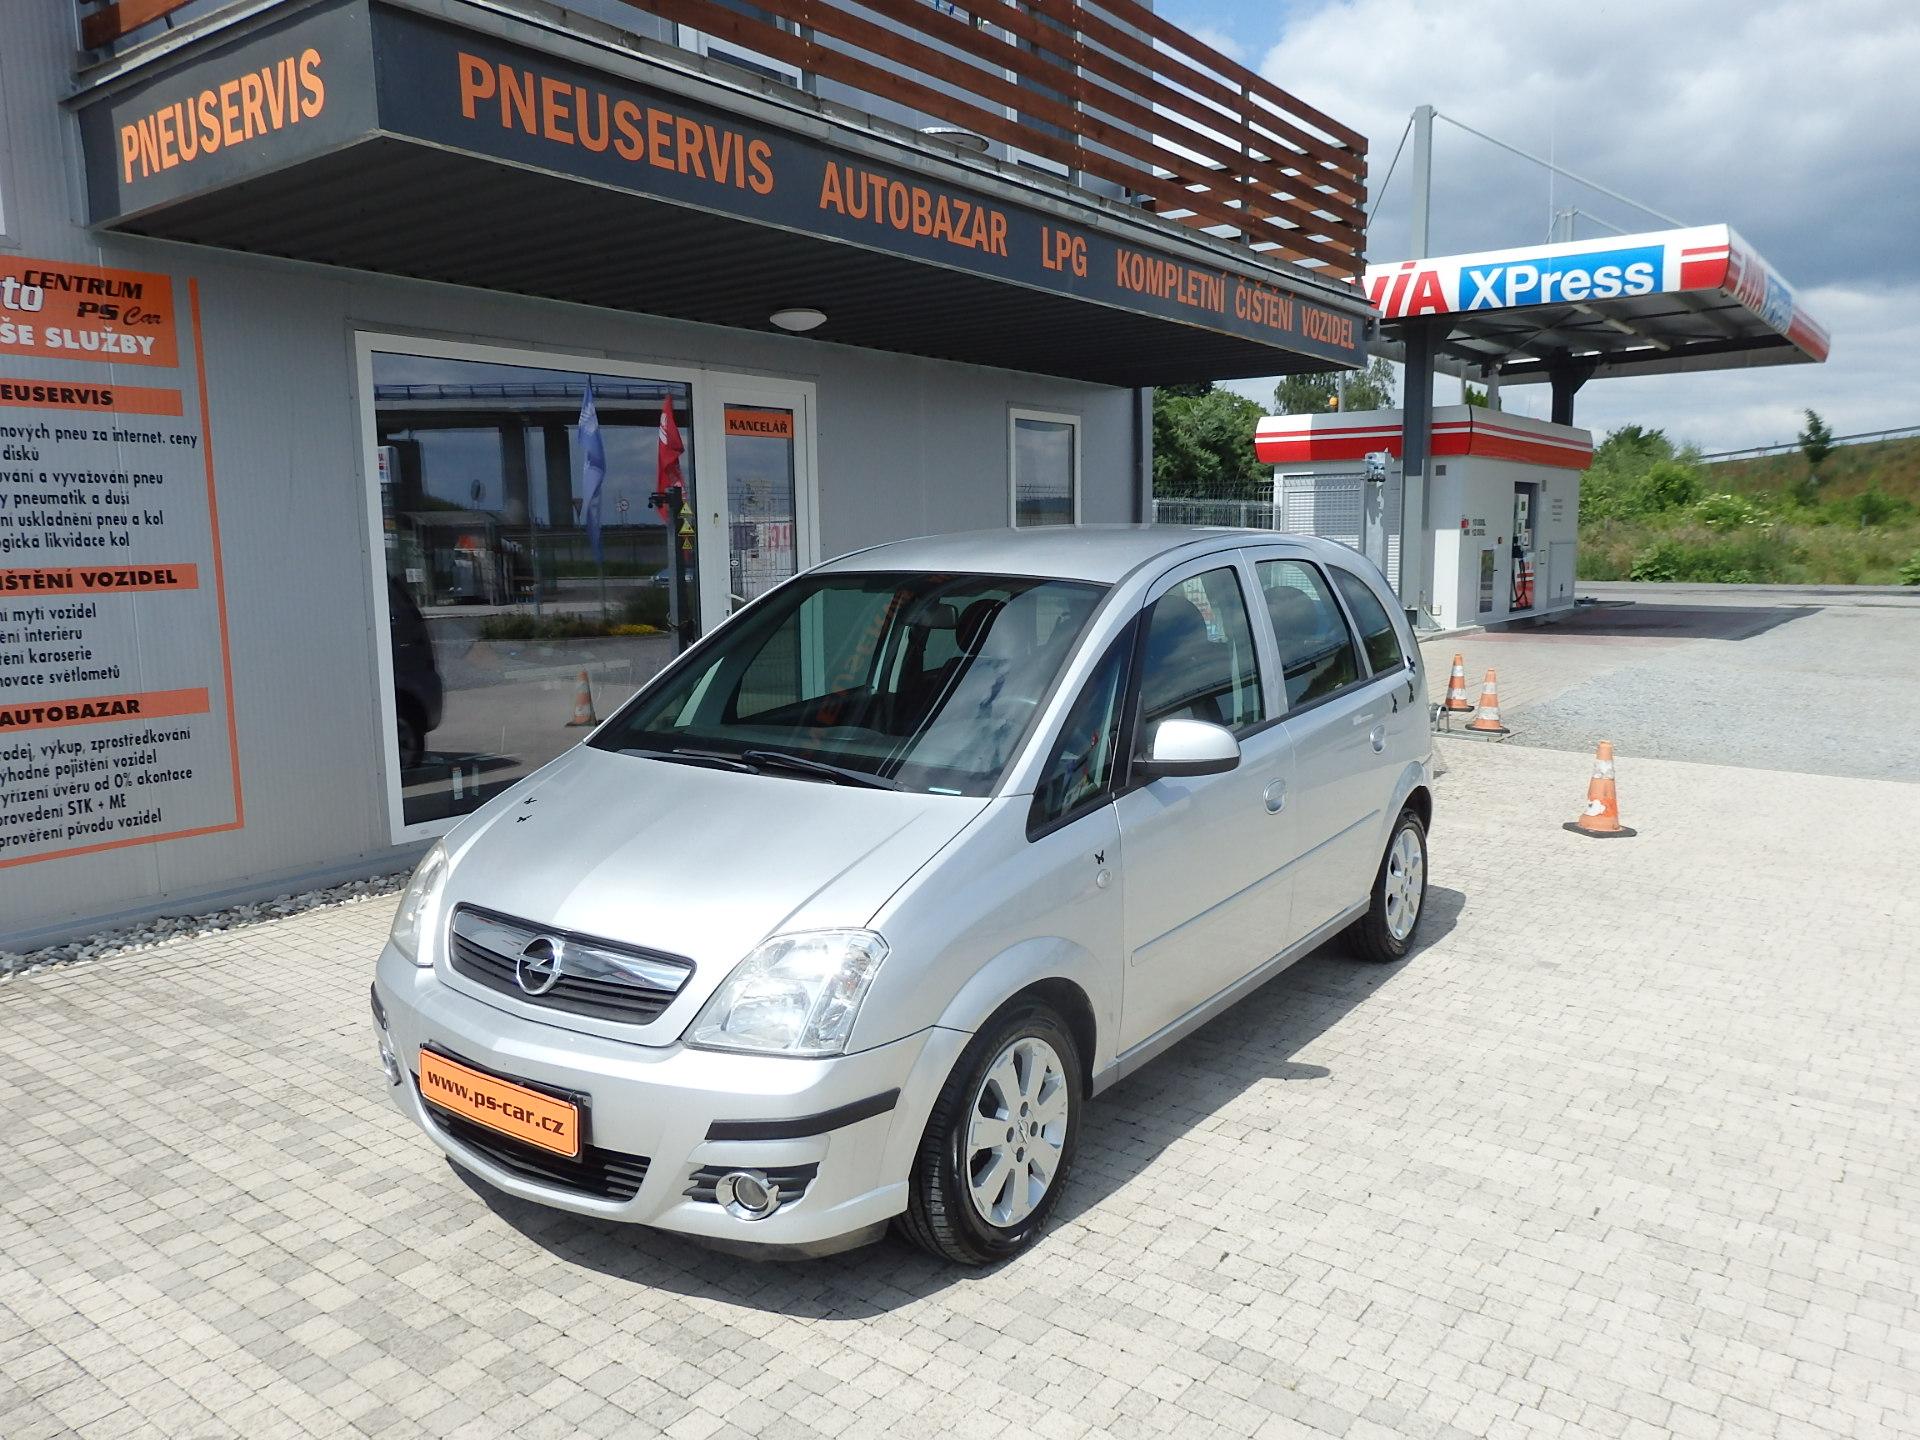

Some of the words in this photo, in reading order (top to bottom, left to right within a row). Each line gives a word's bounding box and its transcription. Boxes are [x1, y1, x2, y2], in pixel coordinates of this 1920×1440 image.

[121, 48, 325, 184] PNEUSERVIS
[457, 51, 774, 195] PNEUSERVIS
[819, 160, 1008, 257] AUTOBAZAR
[1042, 226, 1088, 277] LPG
[1116, 248, 1227, 314] KOMPLETNÍ
[1235, 274, 1296, 332] ČIŠTĚNÍ
[1301, 305, 1355, 349] VOZIDEL
[24, 269, 143, 300] CENTRUM
[1469, 262, 1655, 312] XPress
[76, 301, 119, 321] PS
[123, 306, 162, 326] Car
[0, 316, 34, 346] ŠE
[45, 326, 155, 356] SLUŽBY
[0, 383, 114, 406] EUSERVIS
[0, 423, 50, 442] nových
[55, 428, 88, 443] pneu
[92, 430, 108, 441] za
[112, 427, 166, 445] internet.
[169, 434, 198, 449] ceny
[729, 419, 788, 434] KANCELÁŘ
[3, 444, 39, 461] disků
[40, 472, 47, 483] a
[50, 469, 129, 487] vyvažování
[133, 473, 163, 488] pneu
[14, 490, 87, 509] pneumatik
[92, 494, 100, 505] a
[18, 510, 92, 527] uskladnění
[96, 514, 127, 529] pneu
[132, 516, 140, 525] a
[144, 510, 164, 525] kol
[0, 533, 40, 553] gická
[45, 532, 105, 549] likvidace
[110, 531, 130, 546] kol
[81, 570, 178, 587] VOZIDEL
[49, 602, 97, 619] vozidel
[25, 626, 83, 642] interiéru
[29, 646, 92, 663] karoserie
[49, 665, 120, 684] světlometů
[0, 700, 140, 727] AUTOBAZAR
[91, 726, 191, 753] zprostředkování
[55, 757, 109, 780] pojištění
[113, 749, 157, 768] vozidel
[53, 781, 90, 798] úvěru
[94, 775, 110, 791] od
[114, 772, 133, 790] 0%
[137, 769, 193, 787] akontace
[68, 798, 93, 816] STK
[109, 793, 127, 810] ME
[68, 816, 114, 840] původu
[118, 808, 162, 828] vozidel
[428, 1070, 565, 1136] www.ps-car.cz
